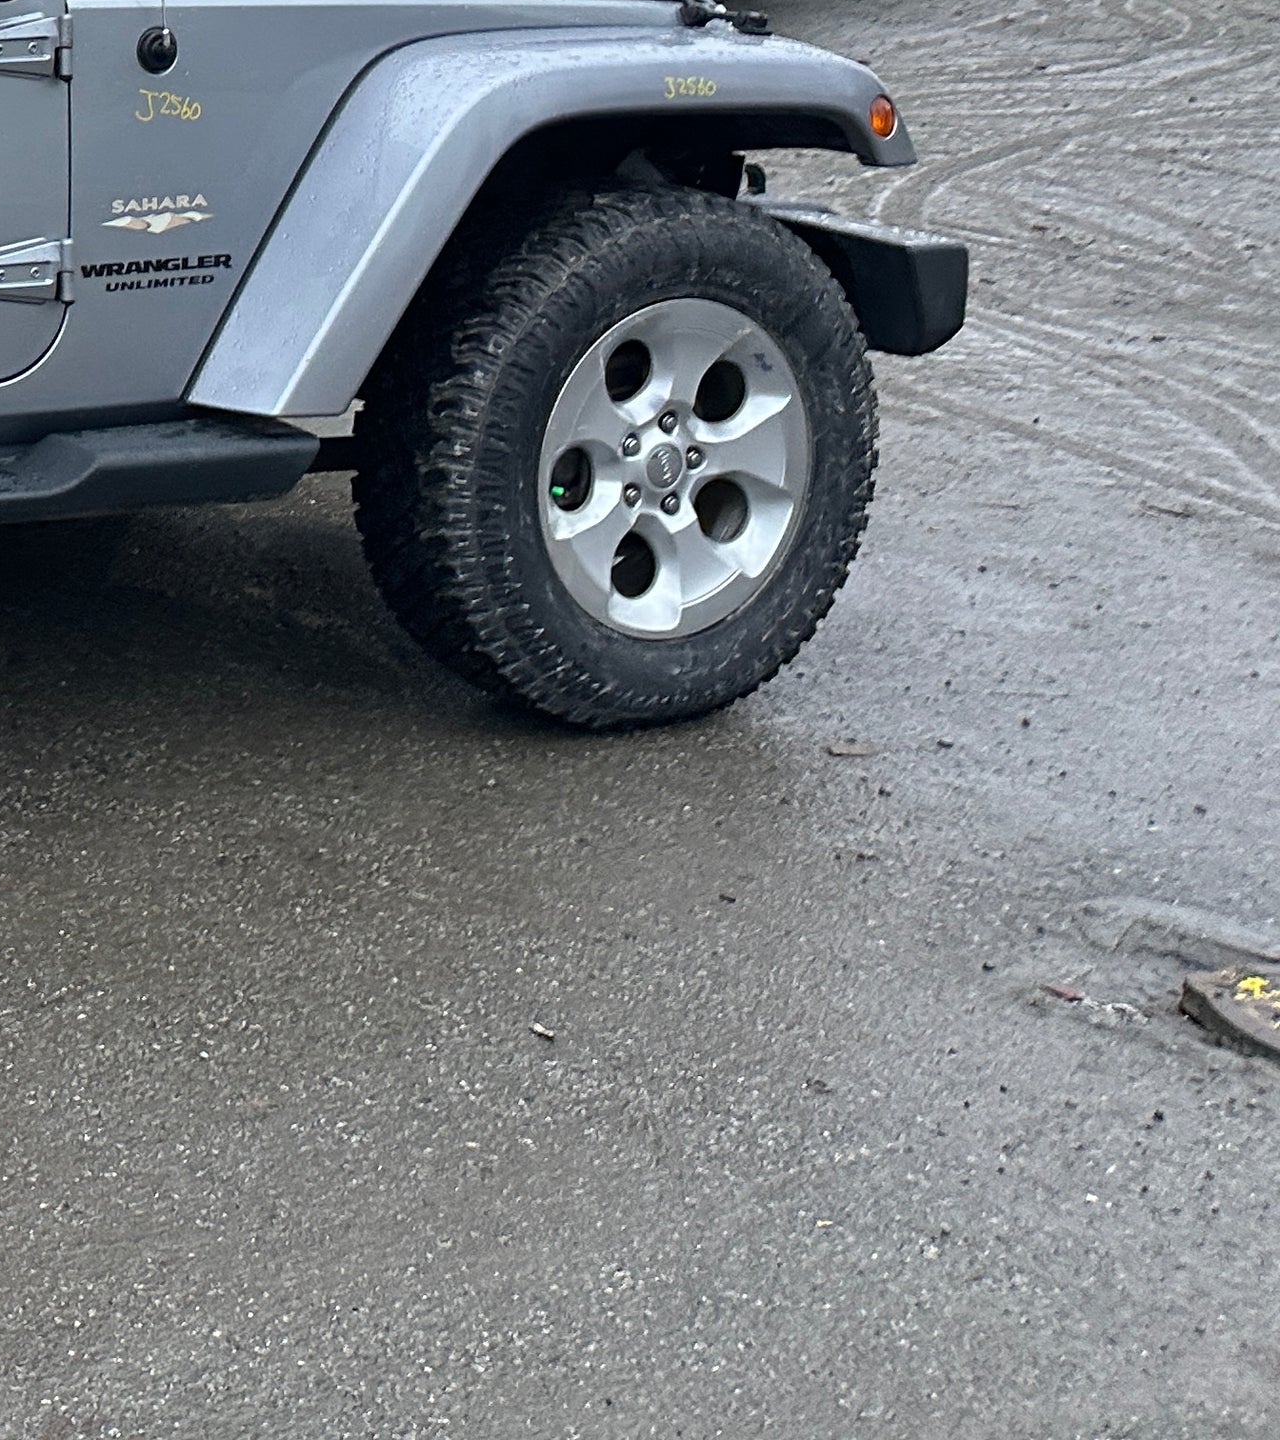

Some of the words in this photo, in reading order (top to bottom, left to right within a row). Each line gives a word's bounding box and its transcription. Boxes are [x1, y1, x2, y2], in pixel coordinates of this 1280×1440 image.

[664, 76, 717, 99] J2560
[135, 88, 202, 122] J2560
[111, 193, 208, 214] SAHARA
[80, 253, 233, 279] WRANGLER
[105, 274, 215, 292] UNLIMITED
